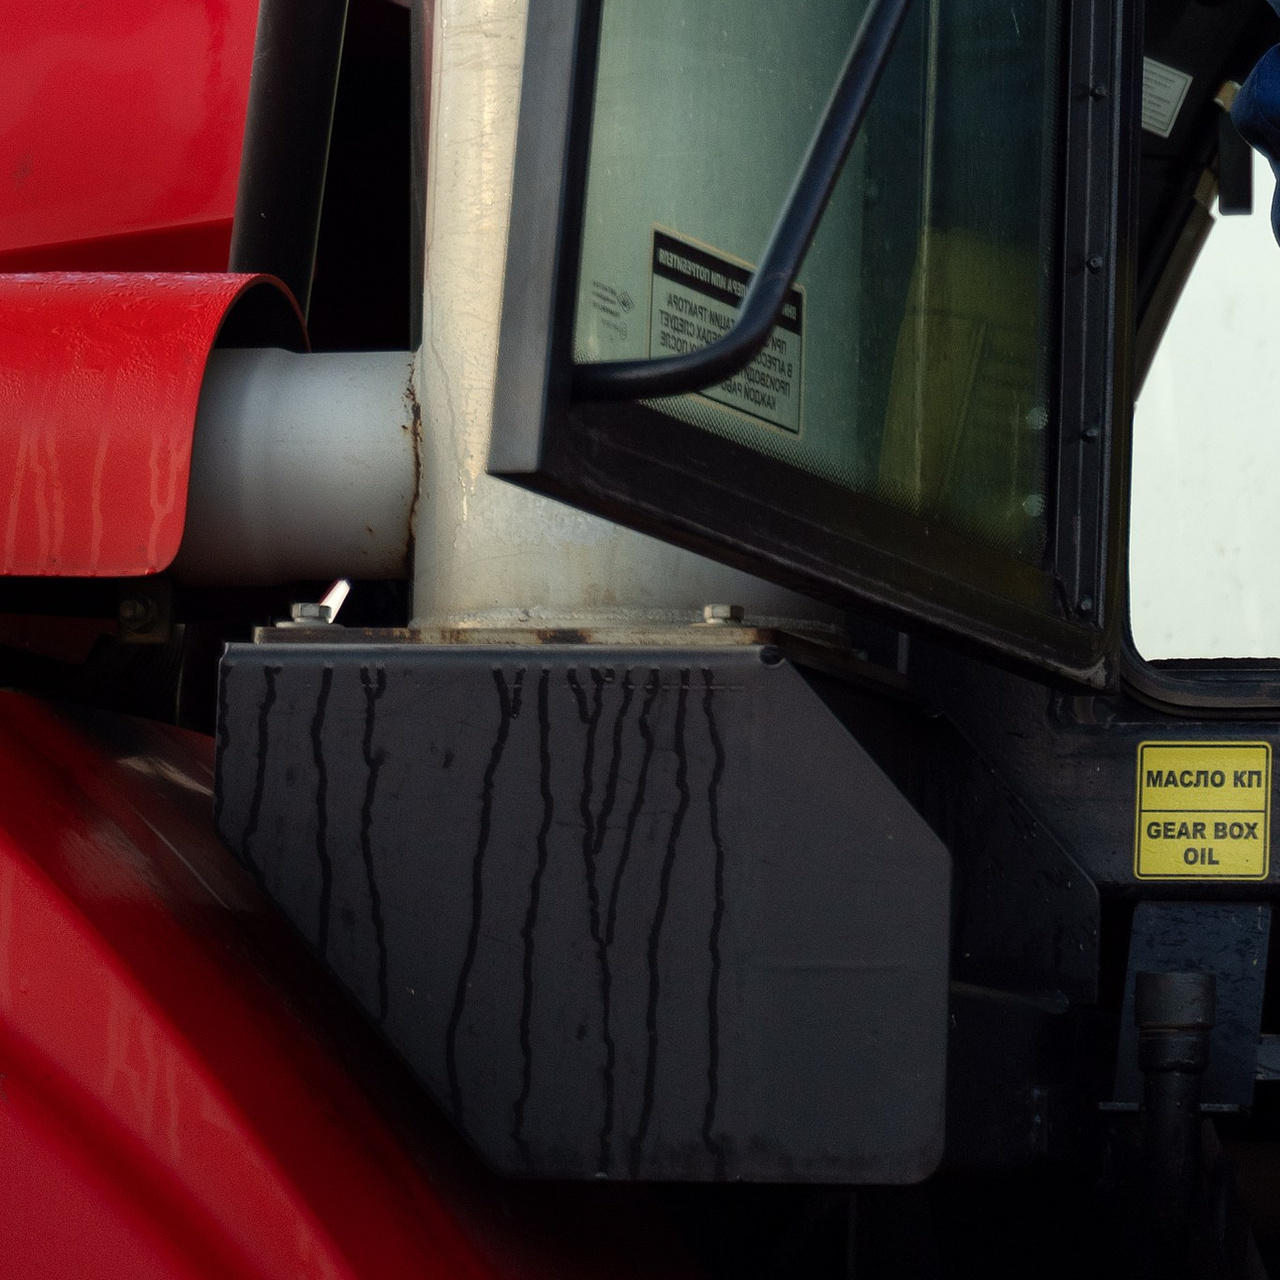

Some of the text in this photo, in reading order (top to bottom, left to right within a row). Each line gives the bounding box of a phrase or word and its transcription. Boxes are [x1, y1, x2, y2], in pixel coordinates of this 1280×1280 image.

[1146, 770, 1262, 788] МАСЛО КП
[1146, 822, 1259, 840] GEAR BOX
[1183, 847, 1220, 865] OIL
